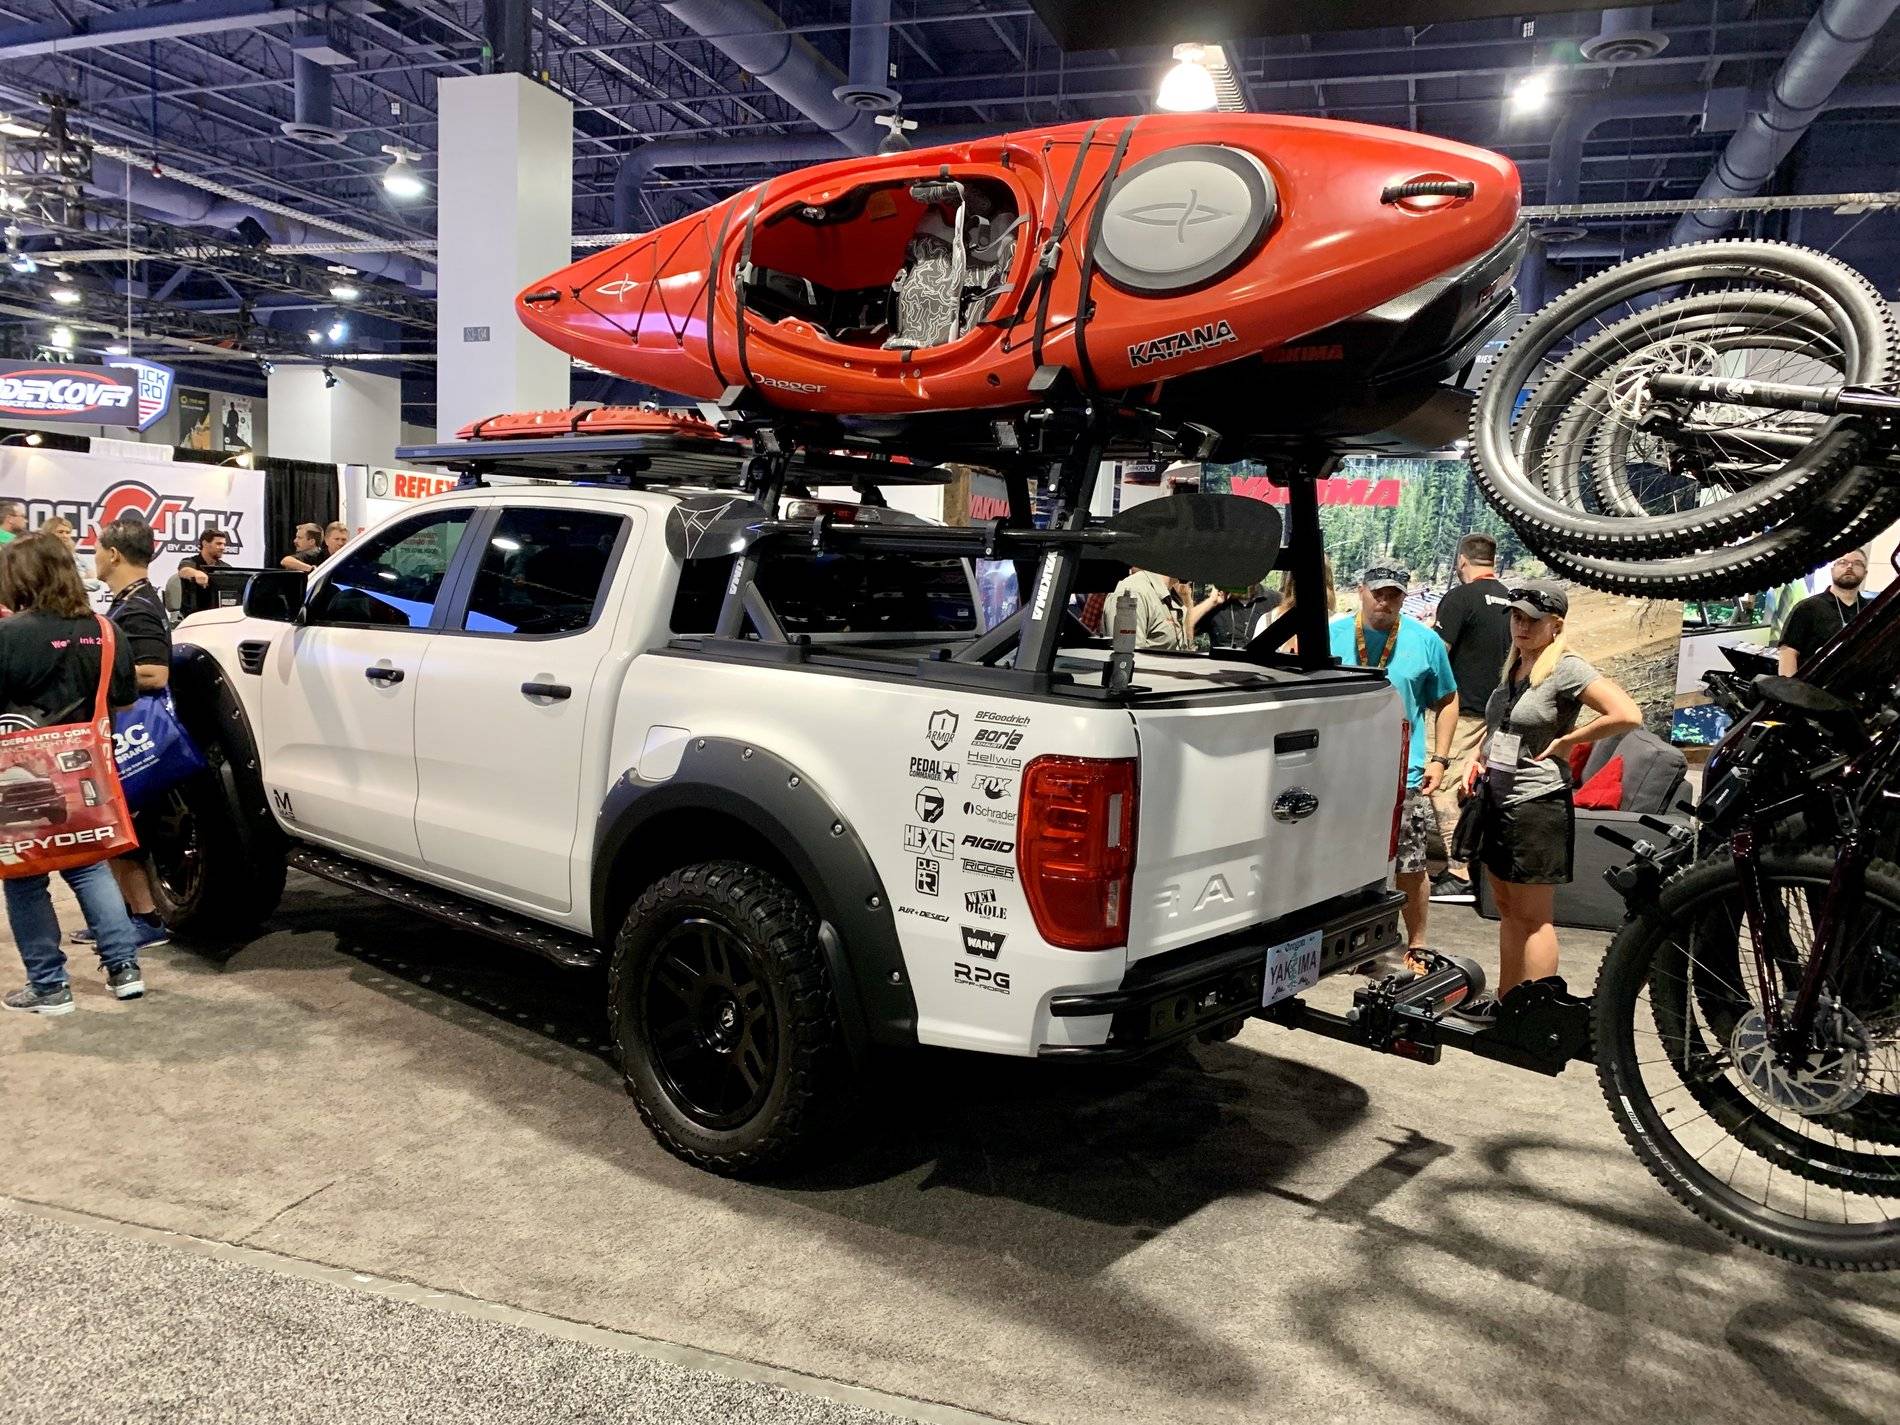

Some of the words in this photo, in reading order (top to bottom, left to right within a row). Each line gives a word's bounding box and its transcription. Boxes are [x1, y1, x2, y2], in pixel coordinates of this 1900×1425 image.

[1127, 320, 1239, 367] KATANA
[751, 371, 827, 394] Dagger
[1230, 476, 1400, 507] YAIMA
[1031, 551, 1058, 620] YAKIMA
[975, 710, 1031, 725] BFGoodrich
[925, 730, 955, 743] ARMOR
[910, 757, 942, 774] PEDAL
[967, 750, 1022, 768] Hellwig
[975, 804, 1018, 821] Schrader
[904, 824, 954, 860] HEXIS
[961, 835, 1015, 854] RIGID
[961, 857, 1016, 879] TRIGGER
[966, 889, 996, 904] WET
[966, 902, 1007, 919] OKOLE
[967, 936, 996, 952] WARN
[955, 962, 1010, 989] RPG
[955, 978, 1010, 995] OFF-ROAD
